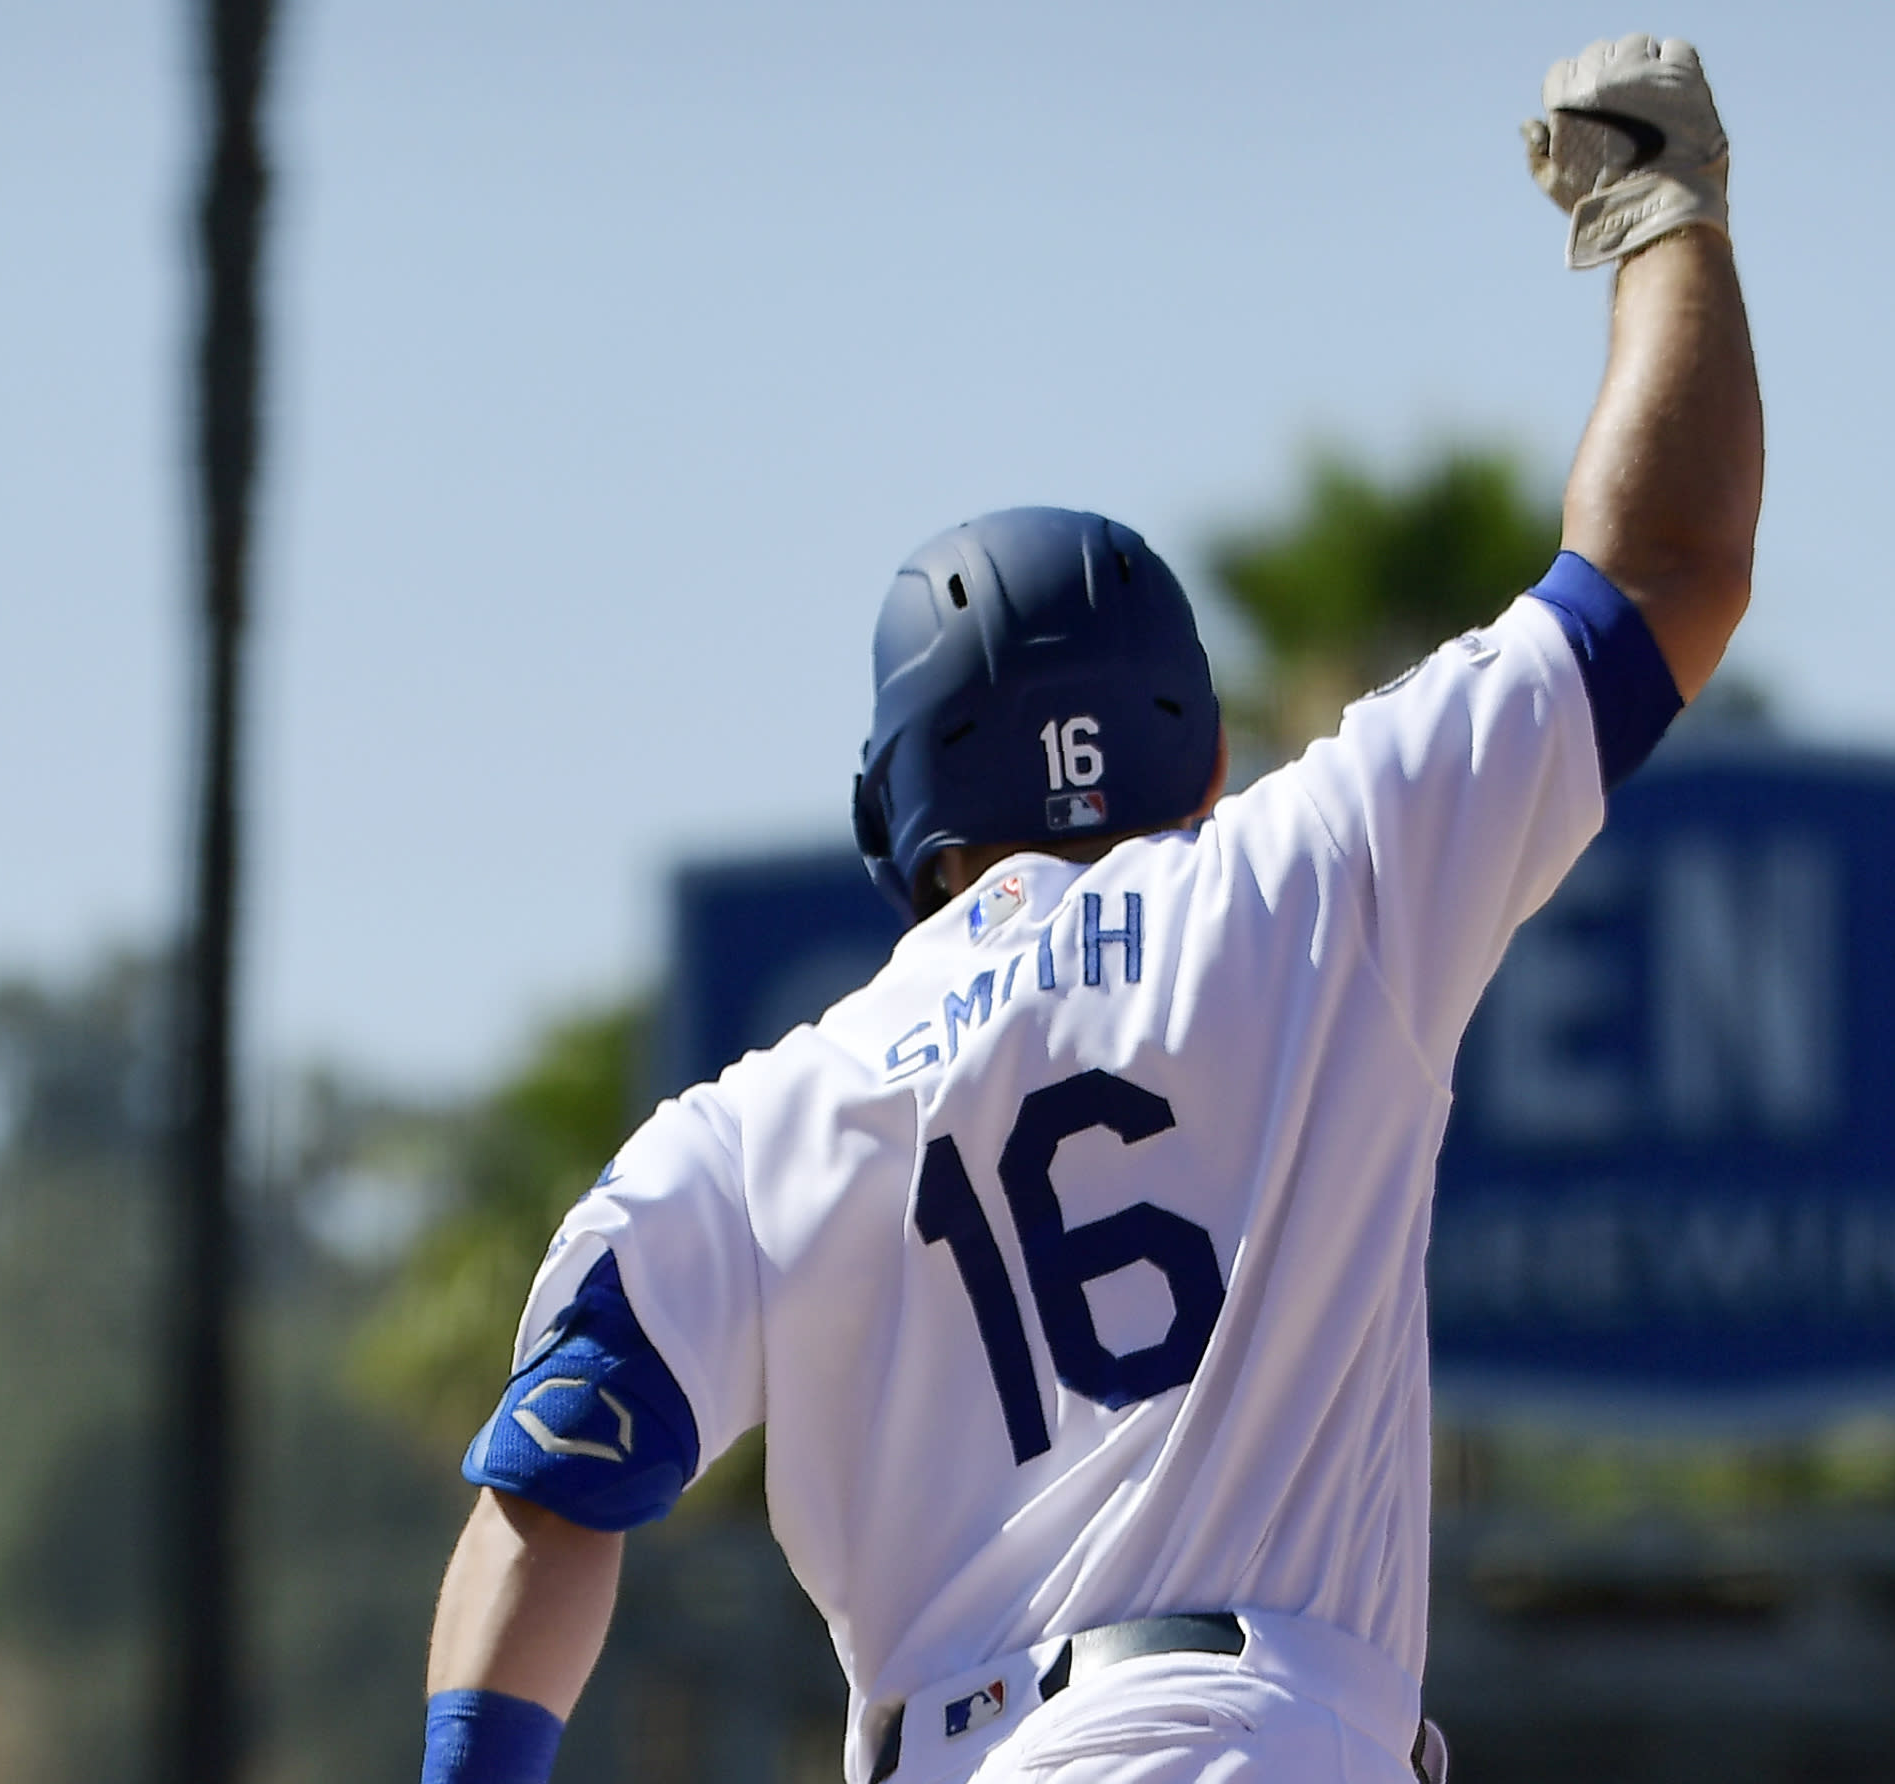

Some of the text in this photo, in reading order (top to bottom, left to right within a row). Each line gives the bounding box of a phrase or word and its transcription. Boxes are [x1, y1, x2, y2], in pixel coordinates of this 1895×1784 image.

[1039, 716, 1104, 790] 16
[884, 891, 1143, 1084] SMITH
[914, 1068, 1227, 1467] 16
